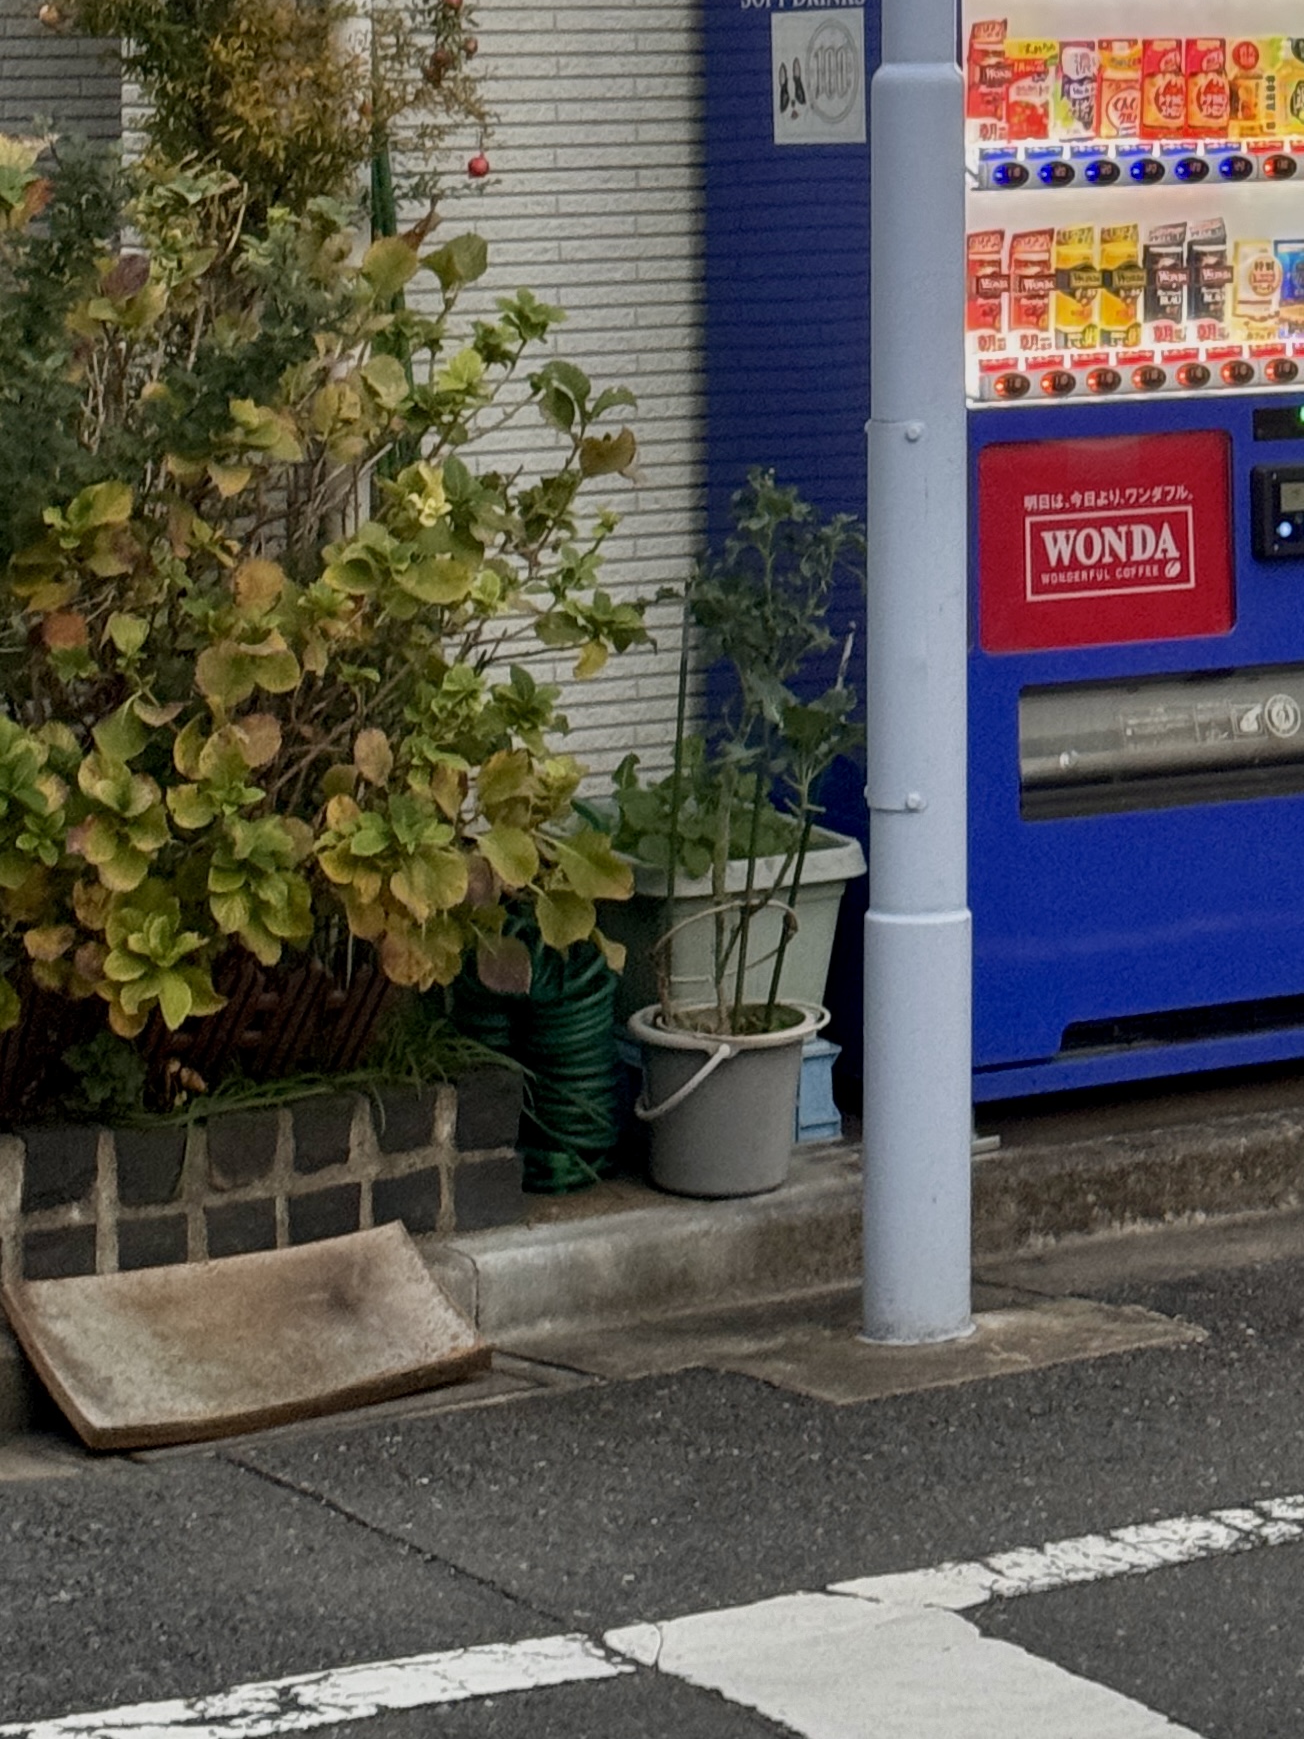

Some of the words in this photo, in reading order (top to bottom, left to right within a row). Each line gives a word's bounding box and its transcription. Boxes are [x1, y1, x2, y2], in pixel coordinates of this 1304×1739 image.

[813, 44, 850, 101] 100
[1040, 521, 1181, 568] WONDA
[1041, 567, 1110, 585] WONDERFUL
[1115, 564, 1160, 580] COFFEE
